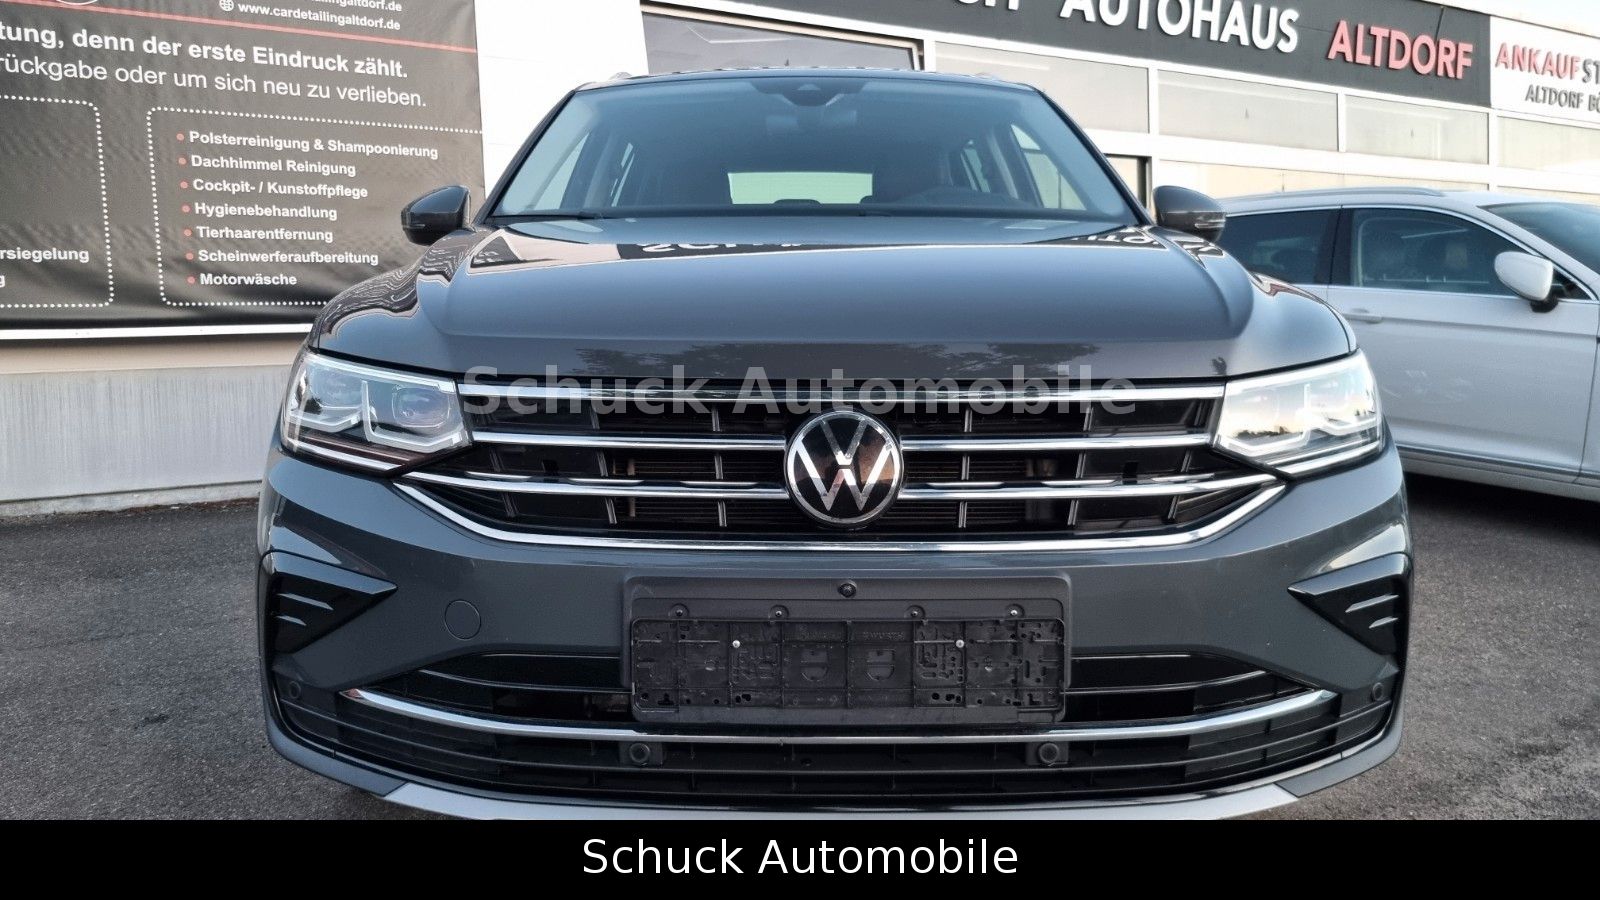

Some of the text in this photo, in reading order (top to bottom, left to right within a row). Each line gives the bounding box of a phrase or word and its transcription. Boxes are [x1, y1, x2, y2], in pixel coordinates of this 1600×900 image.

[238, 5, 401, 30] www.cardetailingaltdorf.de
[72, 29, 135, 52] denn
[142, 36, 182, 56] der
[188, 44, 246, 63] erste
[253, 46, 349, 73] Eindruck
[354, 57, 408, 78] zählt.
[1327, 19, 1474, 80] ALTDORF
[115, 65, 167, 84] oder
[173, 72, 207, 89] um
[214, 73, 257, 93] sich
[263, 80, 301, 97] neu
[307, 84, 330, 99] zu
[336, 86, 427, 107] verlieben.
[1524, 84, 1584, 109] ALTDORF
[189, 131, 438, 160] Polsterreinigung & Shampoonierung
[191, 155, 356, 177] Dachhimmel Reinigung
[193, 178, 368, 200] Cockpit- / Kunstoffpflege
[195, 202, 338, 221] Hygienebehandlung
[197, 226, 334, 243] Tierhaarentfernung
[198, 249, 379, 266] Scheinwerferaufbereitung
[200, 273, 298, 286] Motorwäsche
